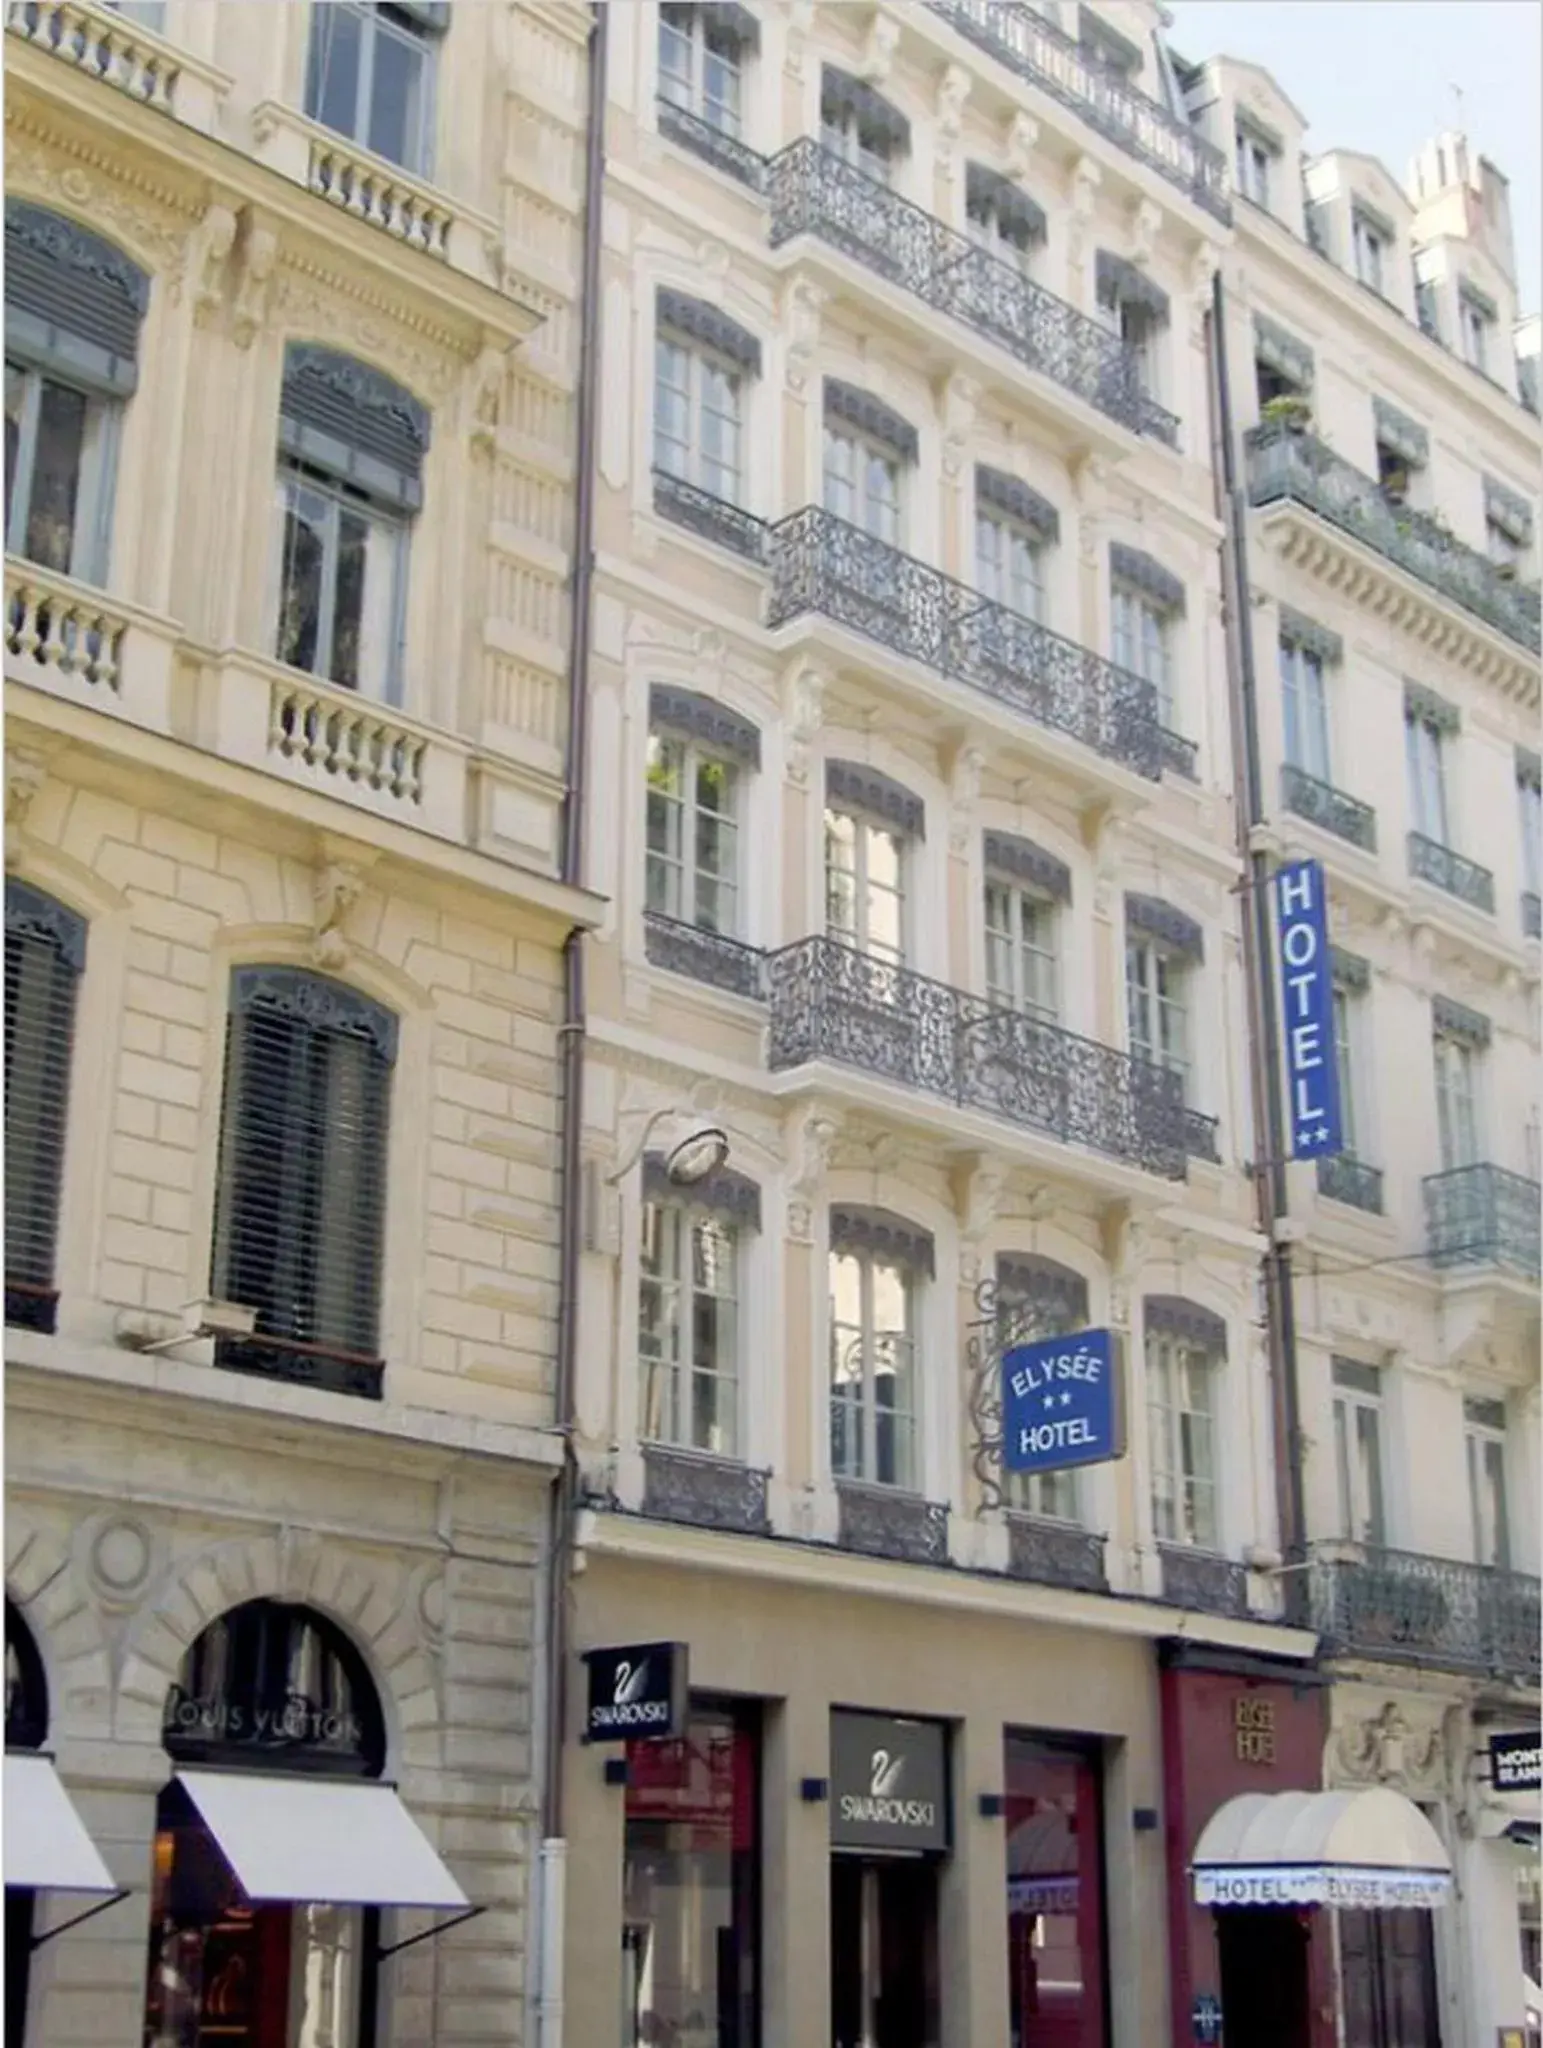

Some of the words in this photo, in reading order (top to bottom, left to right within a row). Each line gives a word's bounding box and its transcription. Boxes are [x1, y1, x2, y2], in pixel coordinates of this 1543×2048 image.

[1280, 868, 1325, 1121] HOTEL
[1010, 1345, 1103, 1397] ELYSÉE
[1020, 1417, 1098, 1453] HOTEL
[590, 1701, 669, 1726] SWAROVSKI
[840, 1794, 934, 1826] SWAROVSKI
[1214, 1879, 1289, 1899] HOTEL
